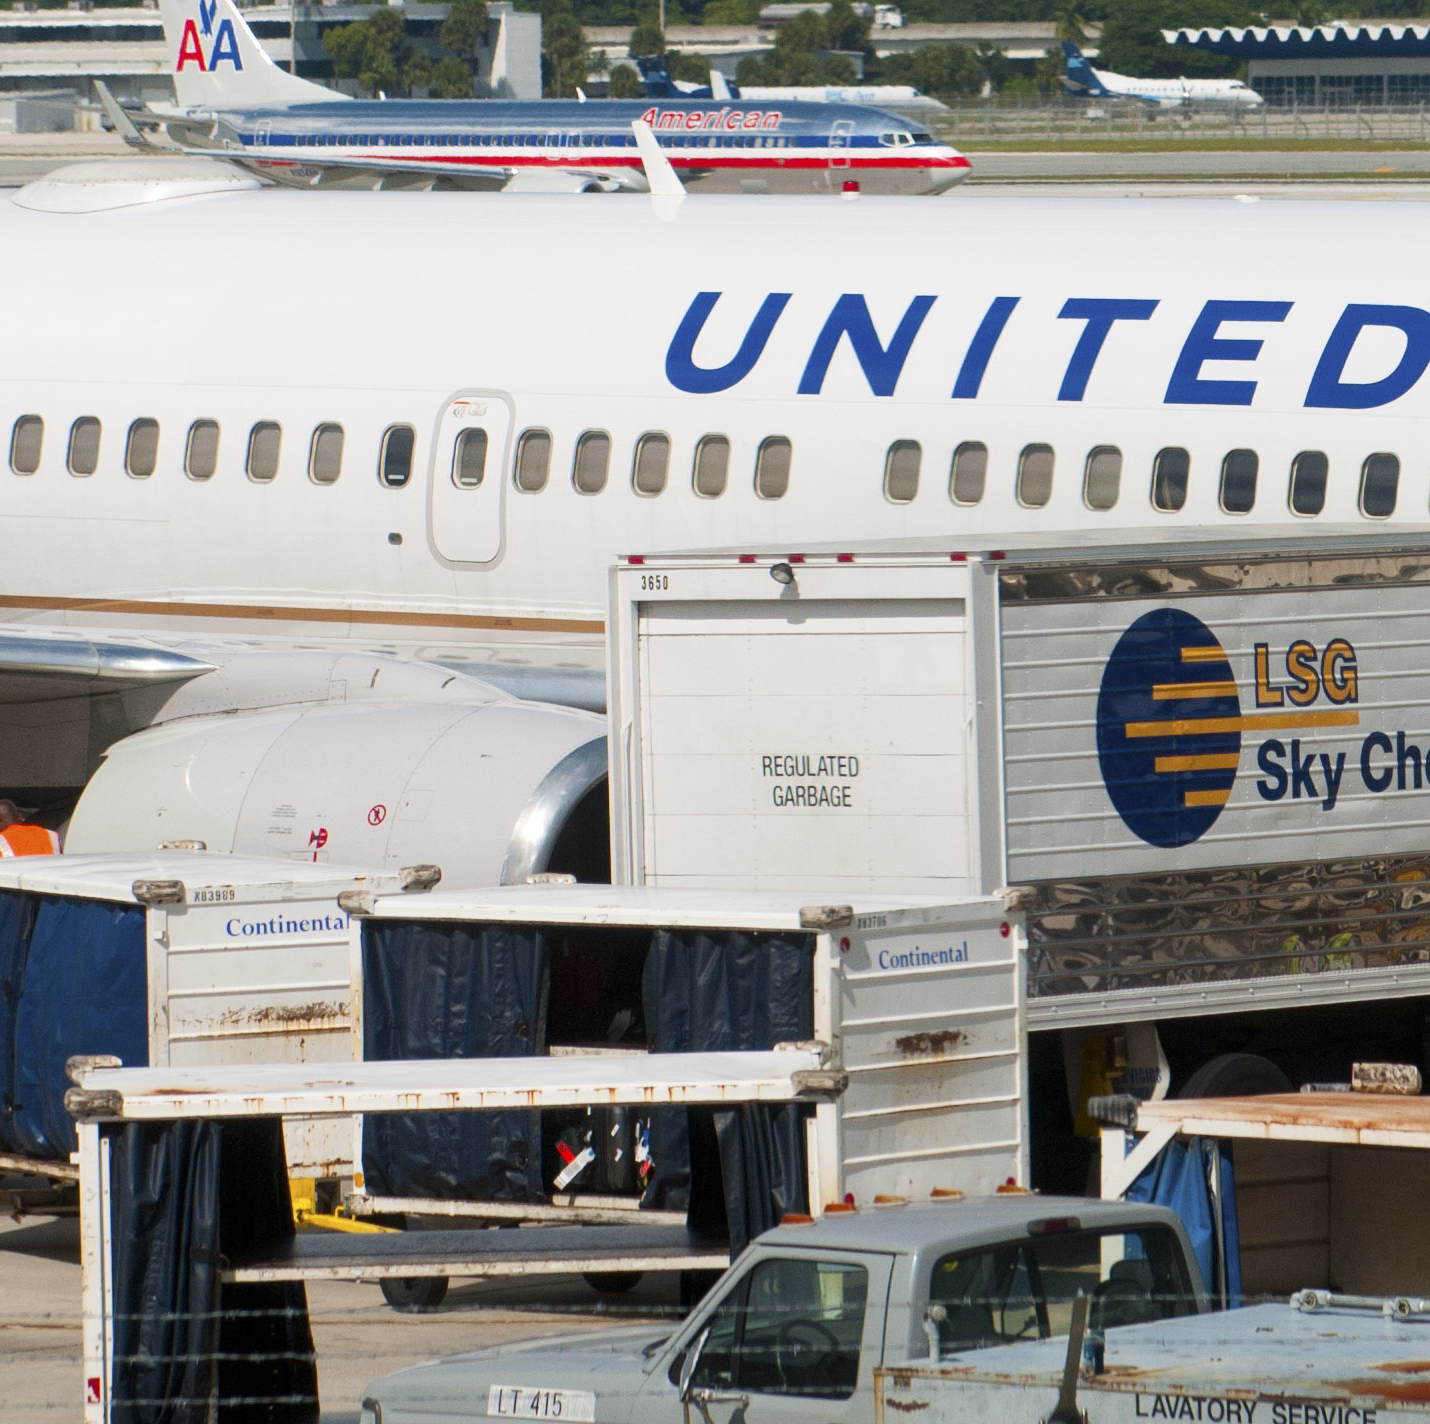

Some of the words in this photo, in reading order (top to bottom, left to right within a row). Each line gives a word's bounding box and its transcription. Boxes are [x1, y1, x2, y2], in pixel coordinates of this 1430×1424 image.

[176, 18, 244, 72] AA
[640, 106, 783, 131] American
[641, 575, 669, 592] 3650
[1254, 638, 1359, 708] LSG
[762, 754, 860, 778] REGULATED
[1256, 739, 1347, 811] Sky
[772, 786, 853, 808] GARBAGE
[226, 913, 350, 937] Continental
[878, 941, 969, 970] Continental
[498, 1388, 523, 1415] LT
[530, 1390, 563, 1417] 415
[1135, 1392, 1258, 1424] LAVATORY
[1272, 1402, 1377, 1424] SERVICE
